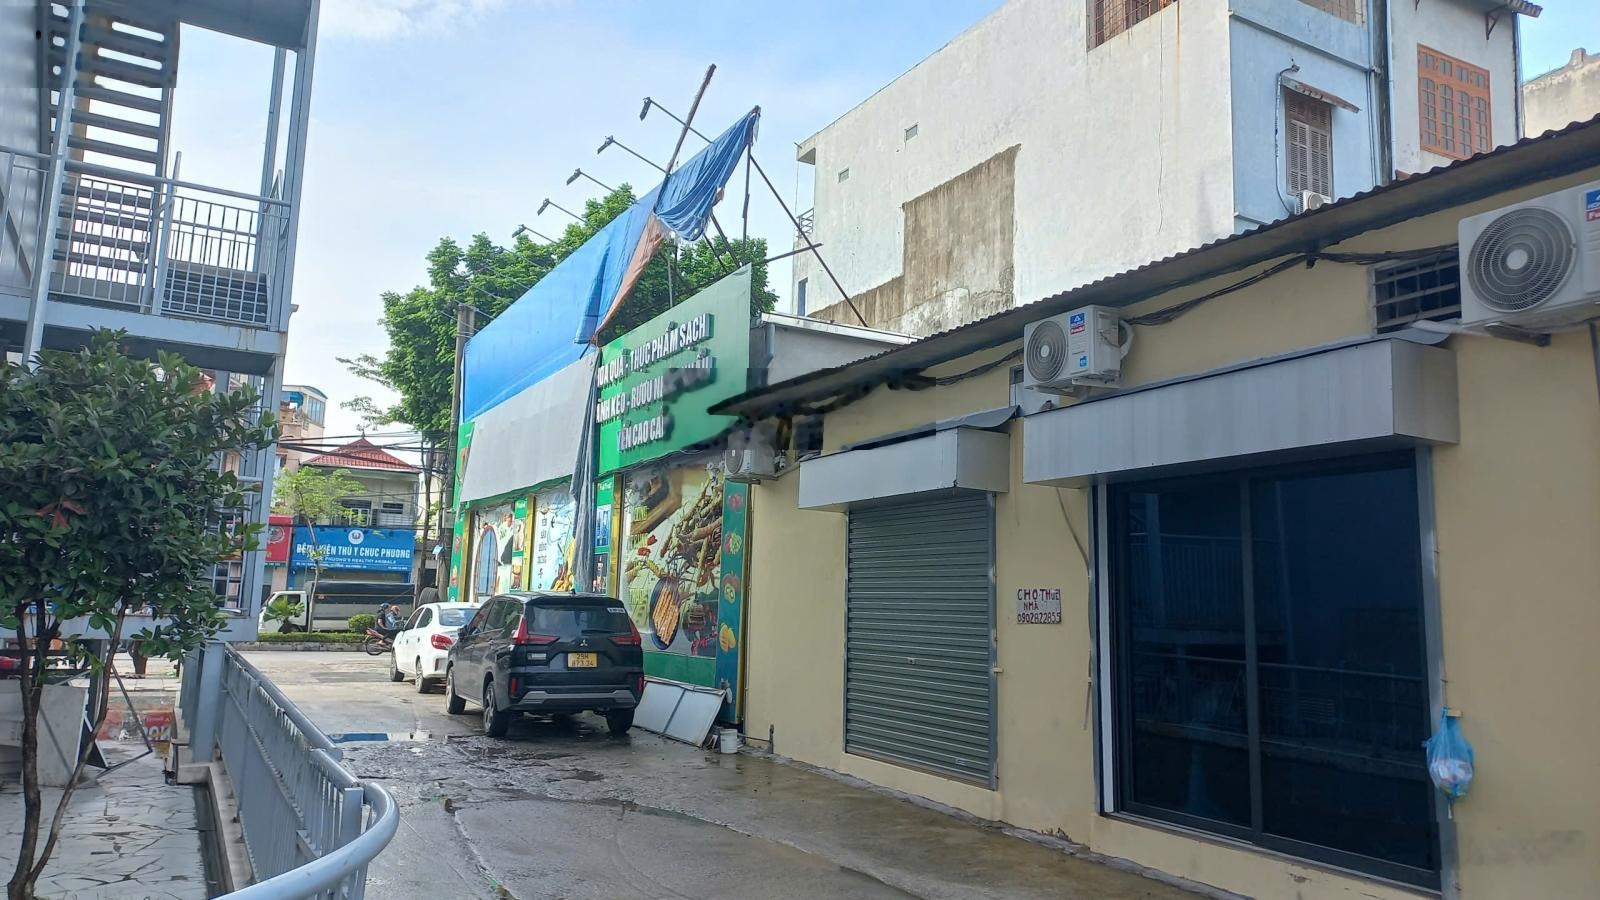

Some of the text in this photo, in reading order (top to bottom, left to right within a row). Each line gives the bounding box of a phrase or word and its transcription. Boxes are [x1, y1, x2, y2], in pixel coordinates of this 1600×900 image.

[679, 312, 707, 350] SẠCH
[596, 397, 611, 423] ÁNH
[632, 420, 649, 446] CAO
[353, 547, 359, 556] Y
[1017, 588, 1038, 601] CHO
